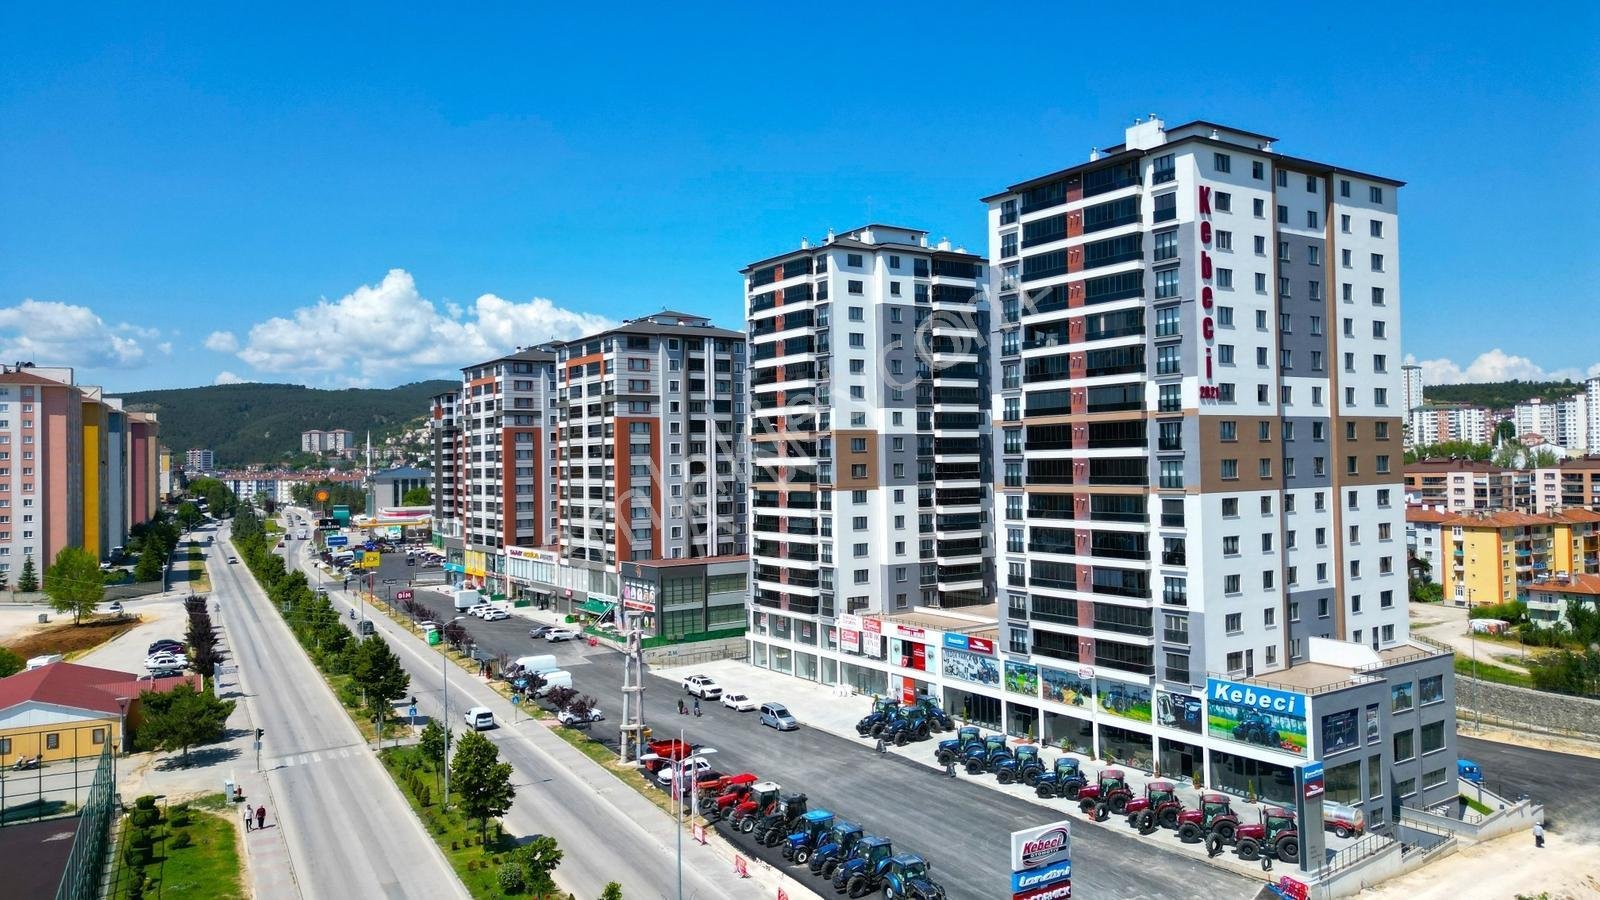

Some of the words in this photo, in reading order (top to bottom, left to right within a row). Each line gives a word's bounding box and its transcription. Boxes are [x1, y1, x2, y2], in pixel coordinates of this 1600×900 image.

[1199, 185, 1214, 380] Kebeci
[1200, 386, 1219, 399] 2021
[1214, 683, 1295, 713] Kebeci
[1023, 834, 1062, 854] Kebeci
